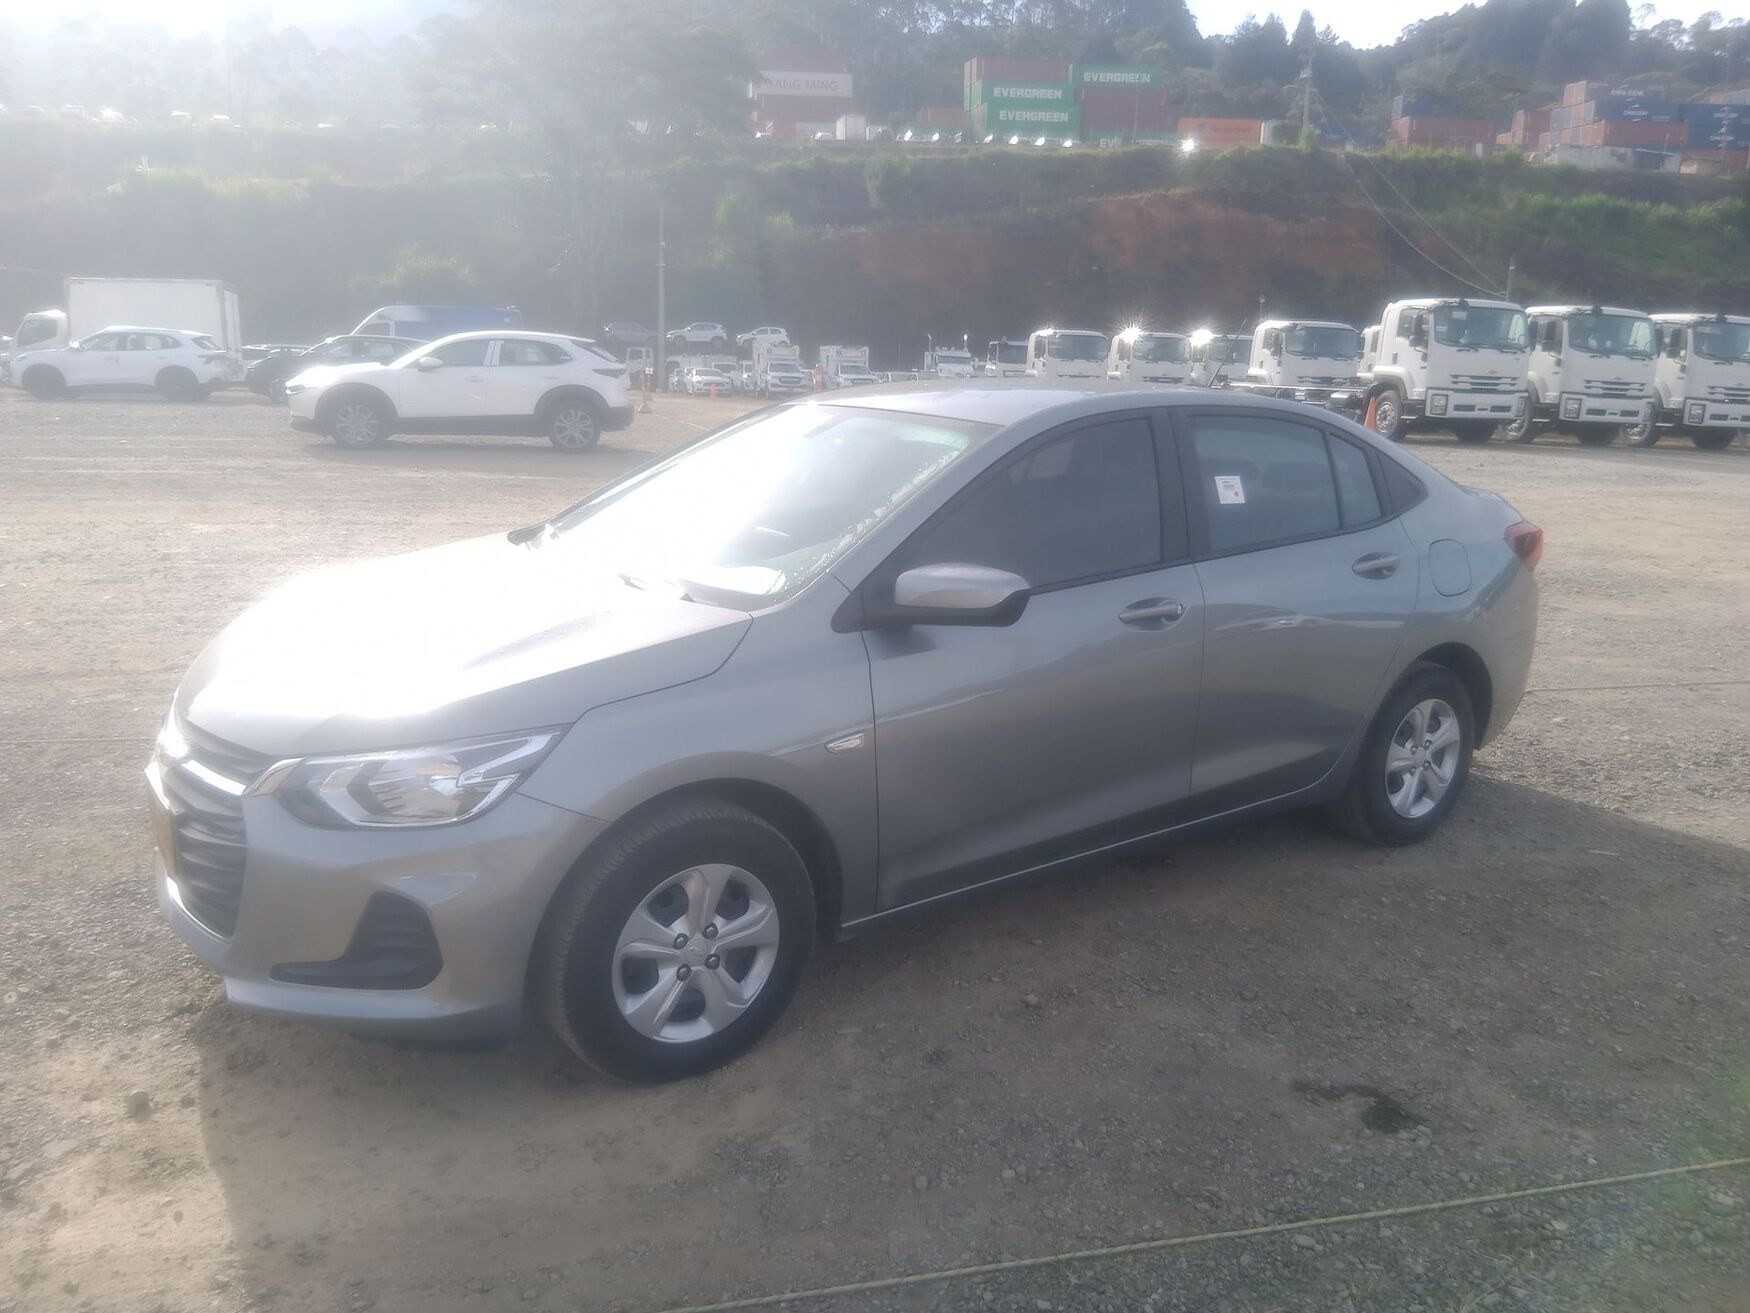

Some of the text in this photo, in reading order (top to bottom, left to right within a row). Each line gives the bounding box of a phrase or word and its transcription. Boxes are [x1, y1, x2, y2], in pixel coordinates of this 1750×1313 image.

[1083, 72, 1150, 83] EVERGREEN
[806, 79, 838, 92] MING
[993, 87, 1062, 99] EVERGREEN
[999, 110, 1069, 122] EVERGREEN
